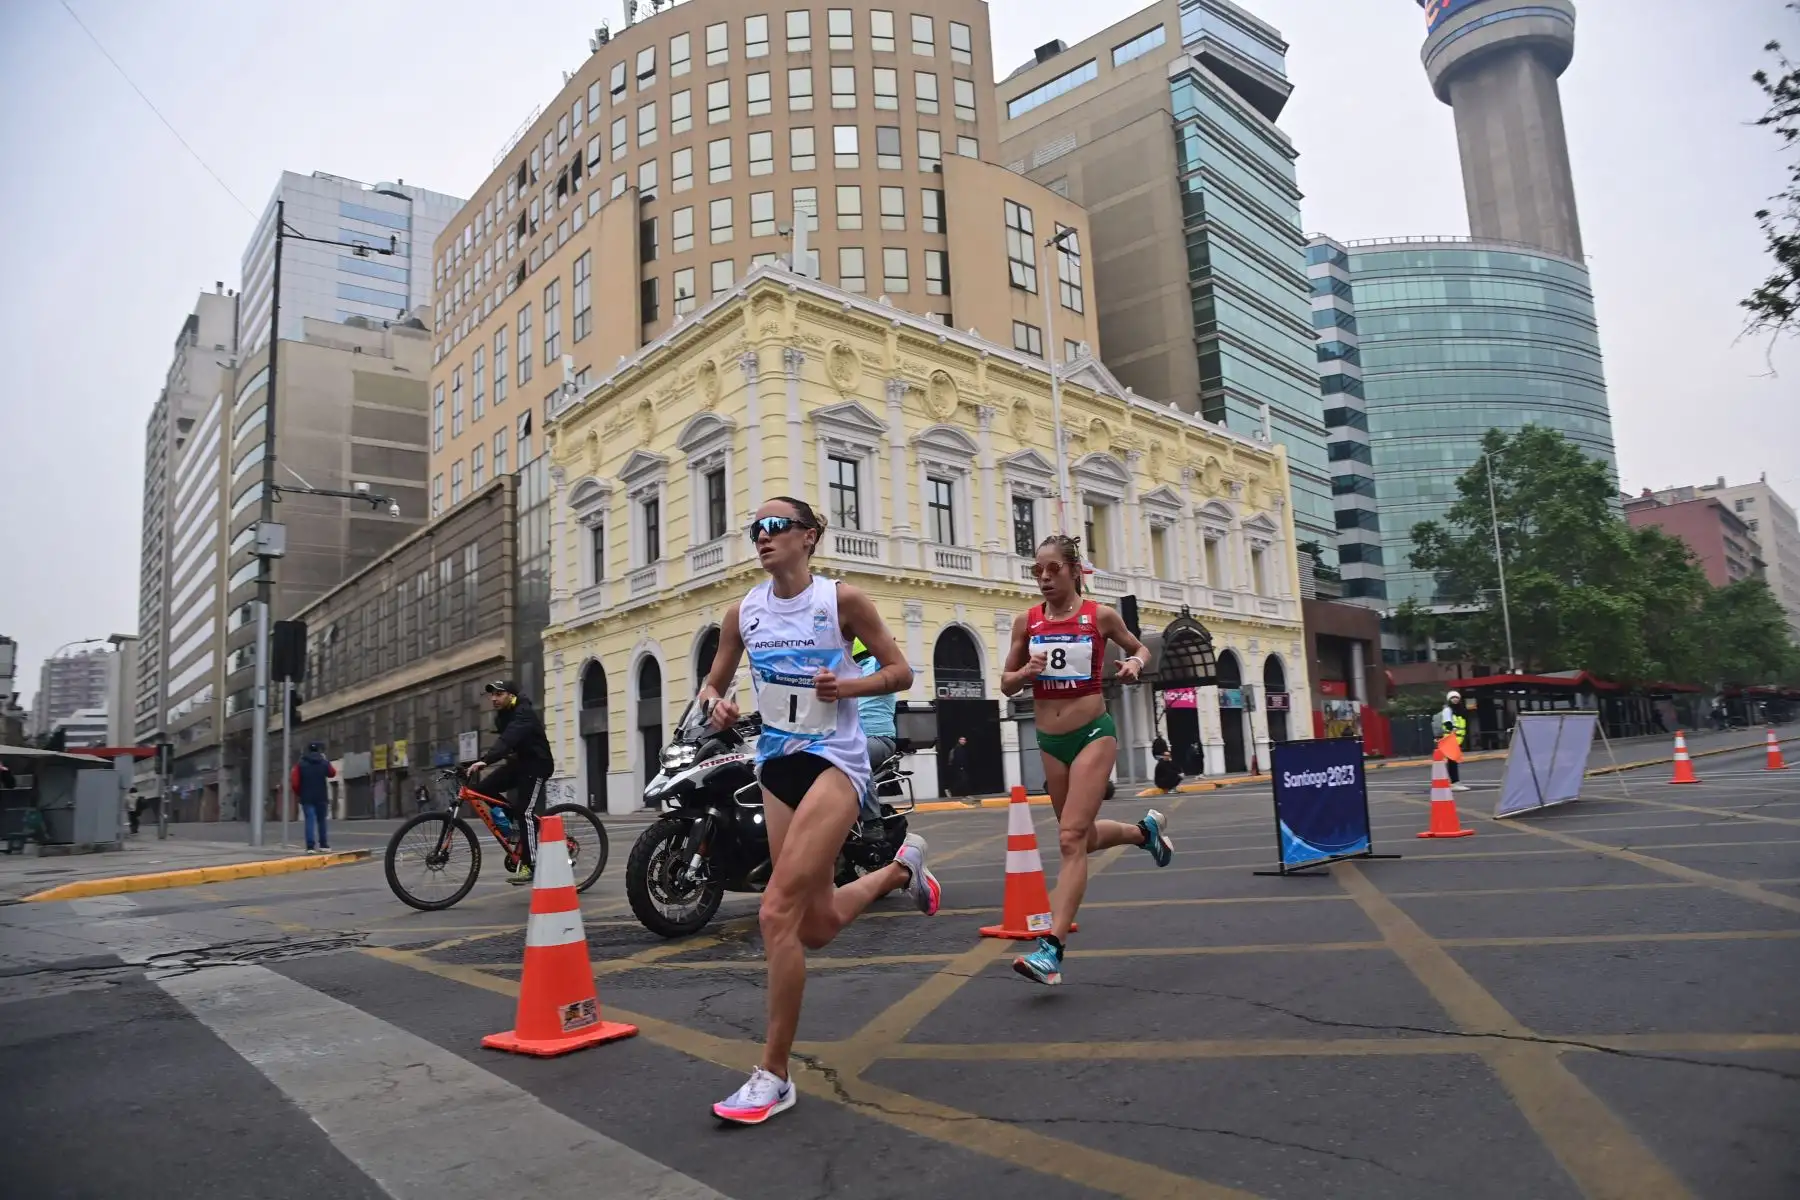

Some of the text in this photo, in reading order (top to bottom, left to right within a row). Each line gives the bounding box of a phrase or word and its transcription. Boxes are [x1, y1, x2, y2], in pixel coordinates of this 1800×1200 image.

[755, 639, 815, 649] ARGENTINA
[1051, 648, 1066, 670] 8
[775, 674, 798, 684] Santiago
[789, 693, 798, 723] 1
[1283, 764, 1355, 788] Santiago 2023
